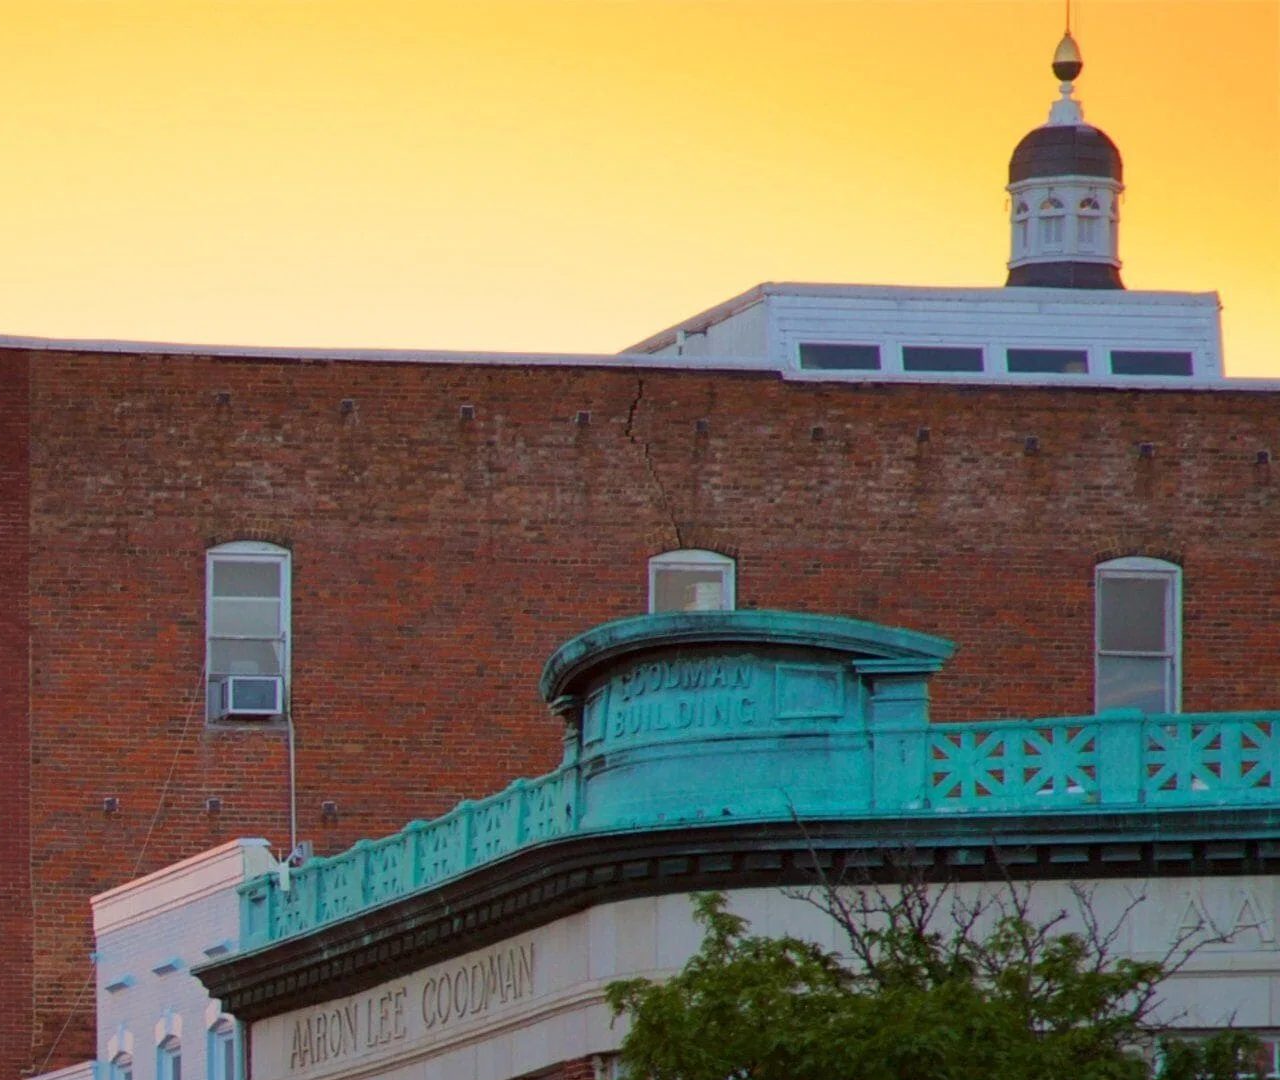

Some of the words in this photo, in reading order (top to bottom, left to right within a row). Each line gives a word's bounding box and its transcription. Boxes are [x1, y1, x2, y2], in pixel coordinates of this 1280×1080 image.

[613, 697, 757, 738] BUILDING
[290, 1002, 359, 1069] AARON
[365, 987, 408, 1048] LEE
[422, 942, 536, 1029] GOODMAN
